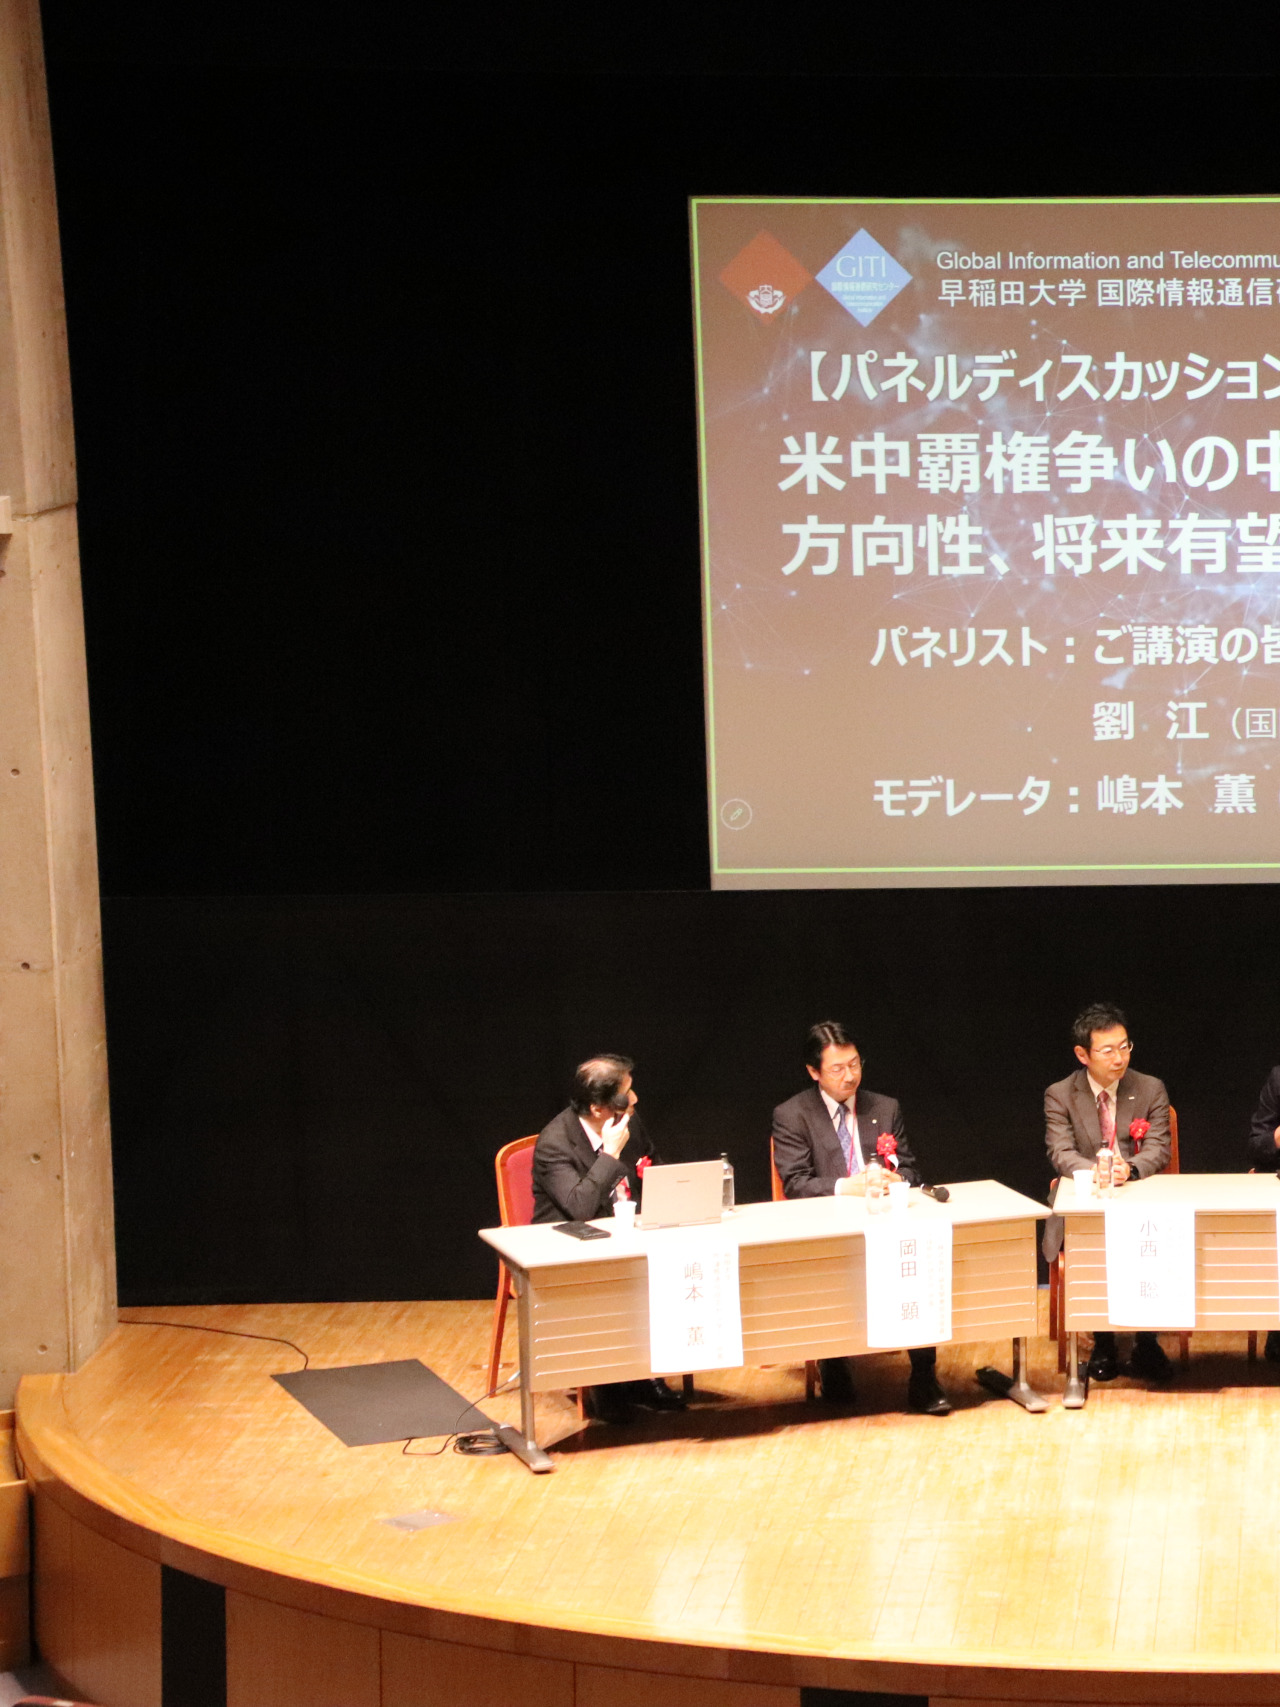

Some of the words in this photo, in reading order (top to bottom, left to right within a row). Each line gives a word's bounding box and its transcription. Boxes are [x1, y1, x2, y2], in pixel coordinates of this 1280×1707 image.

[836, 255, 887, 278] GITI
[936, 250, 1002, 270] Global
[1008, 250, 1123, 270] Information
[1128, 249, 1165, 269] and
[937, 278, 1087, 308] 早稲田大学
[1092, 700, 1134, 741] 劉
[1139, 1219, 1159, 1257] 小西
[899, 1239, 917, 1278] 岡田
[684, 1261, 704, 1302] 嶋本
[687, 1326, 705, 1347] 薫
